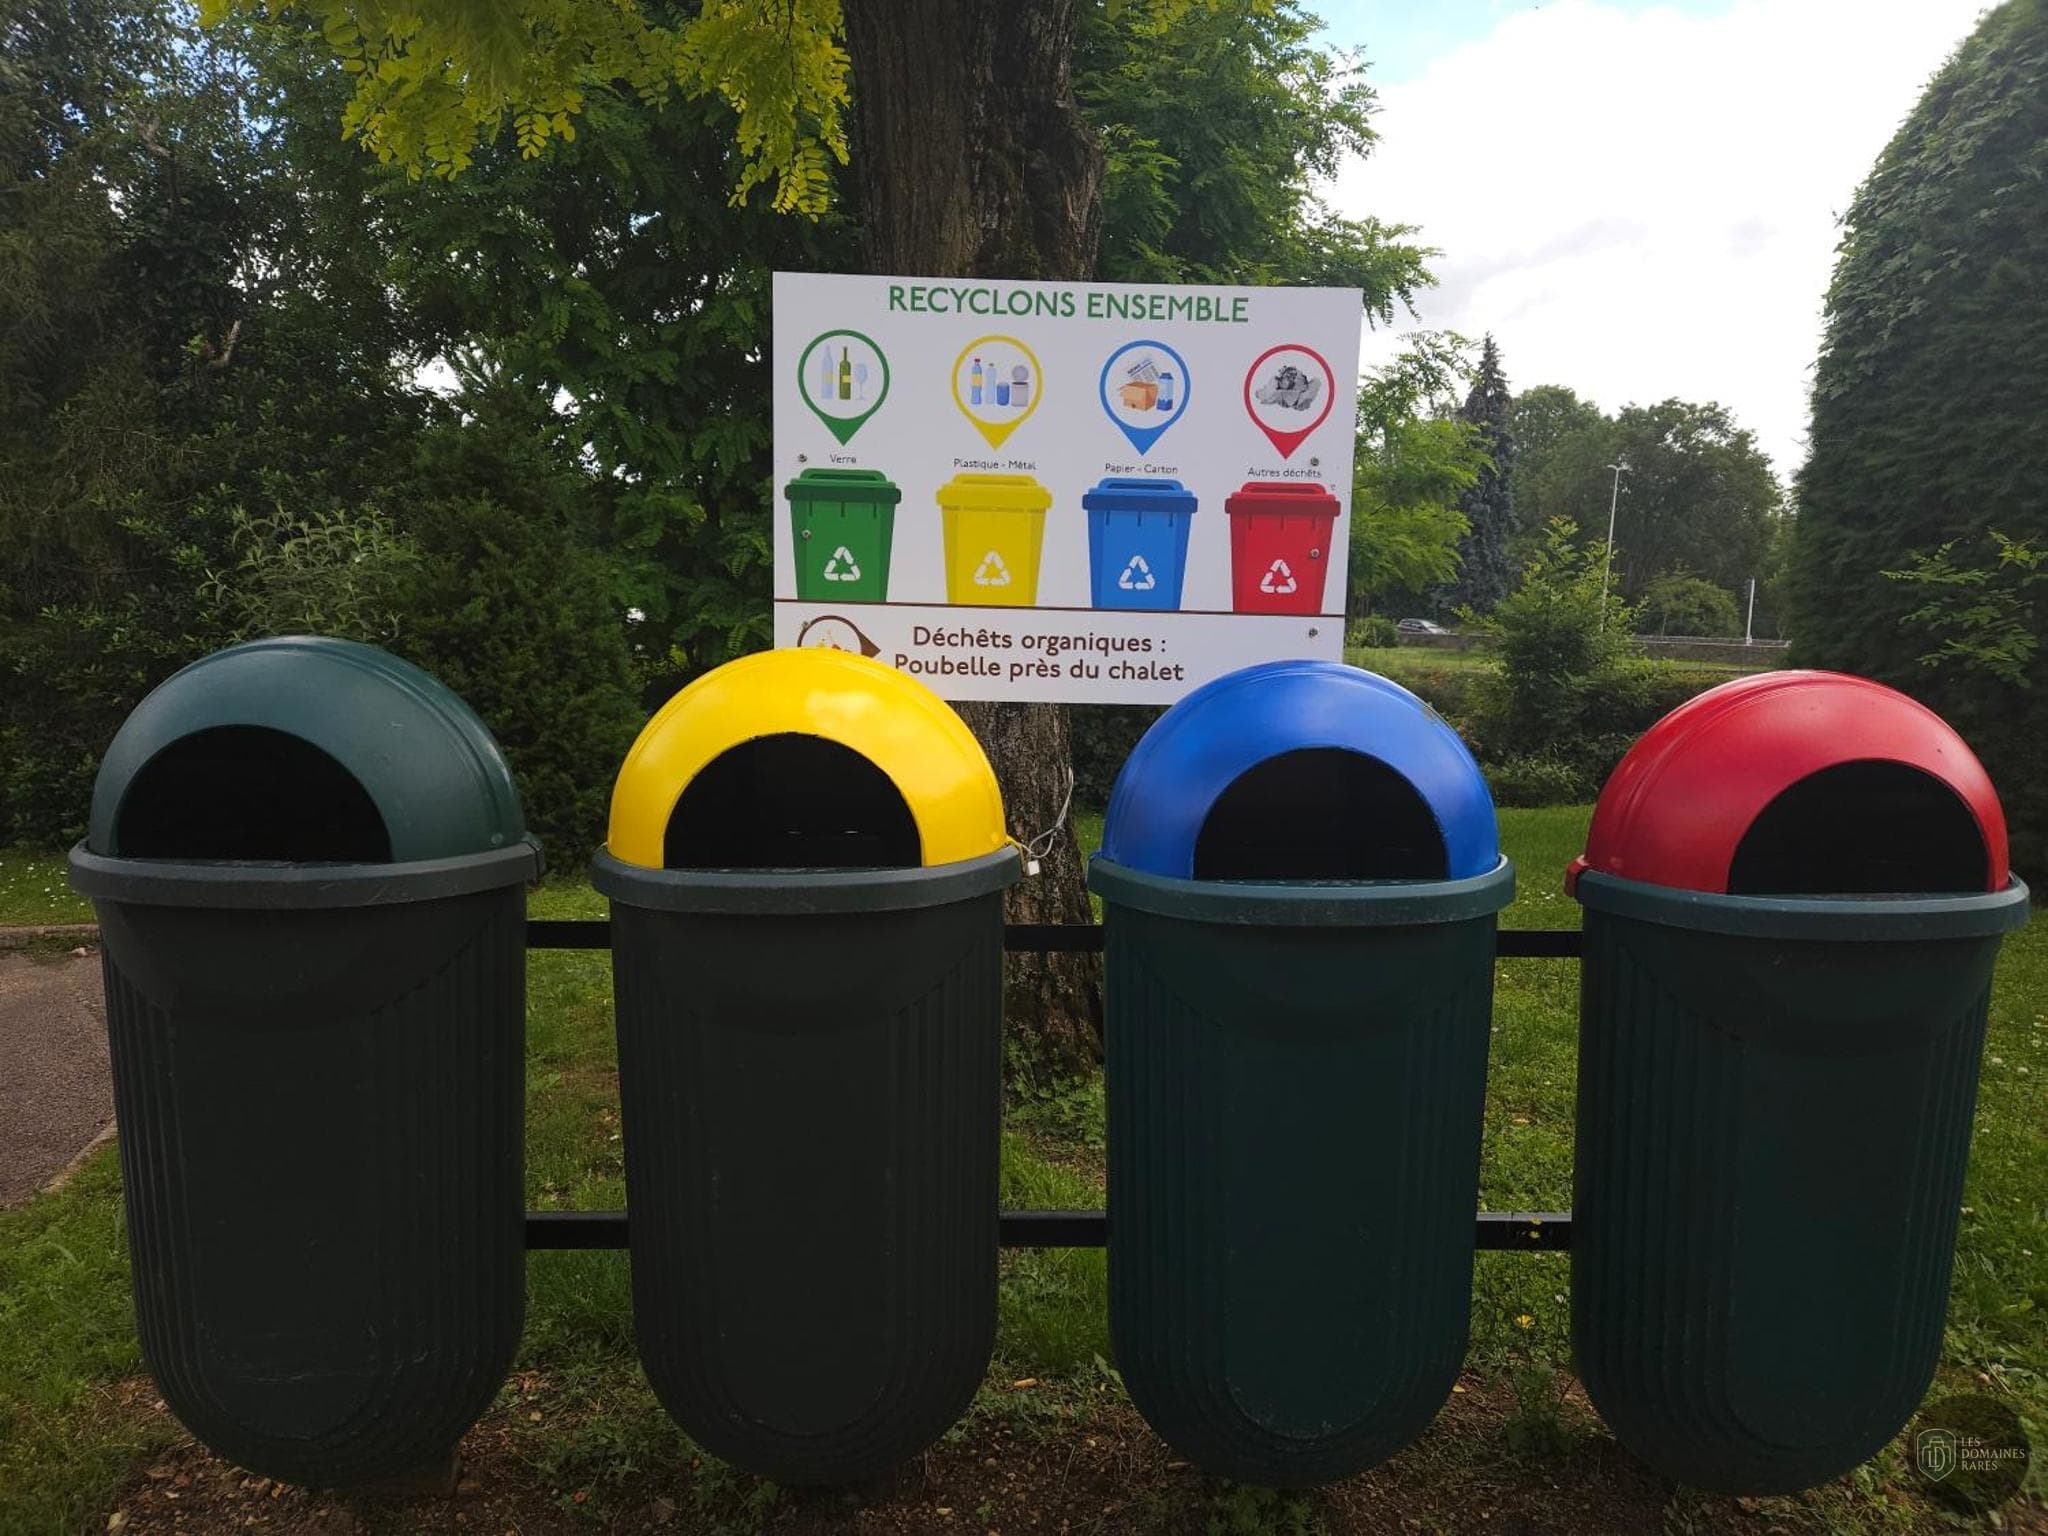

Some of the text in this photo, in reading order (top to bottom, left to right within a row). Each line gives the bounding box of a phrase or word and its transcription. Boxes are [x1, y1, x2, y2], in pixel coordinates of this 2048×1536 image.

[889, 285, 1250, 323] RECYCLONS ENSEMBLE
[829, 454, 857, 464] Verre
[953, 458, 999, 470] Plastique
[1008, 459, 1036, 471] Métal
[1105, 463, 1135, 475] Papier
[1144, 463, 1178, 474] Carton
[1248, 467, 1281, 478] Autres
[913, 626, 1012, 648] Déchêts
[1021, 632, 1152, 657] organiques
[895, 654, 1184, 682] Poubelle près du chalet
